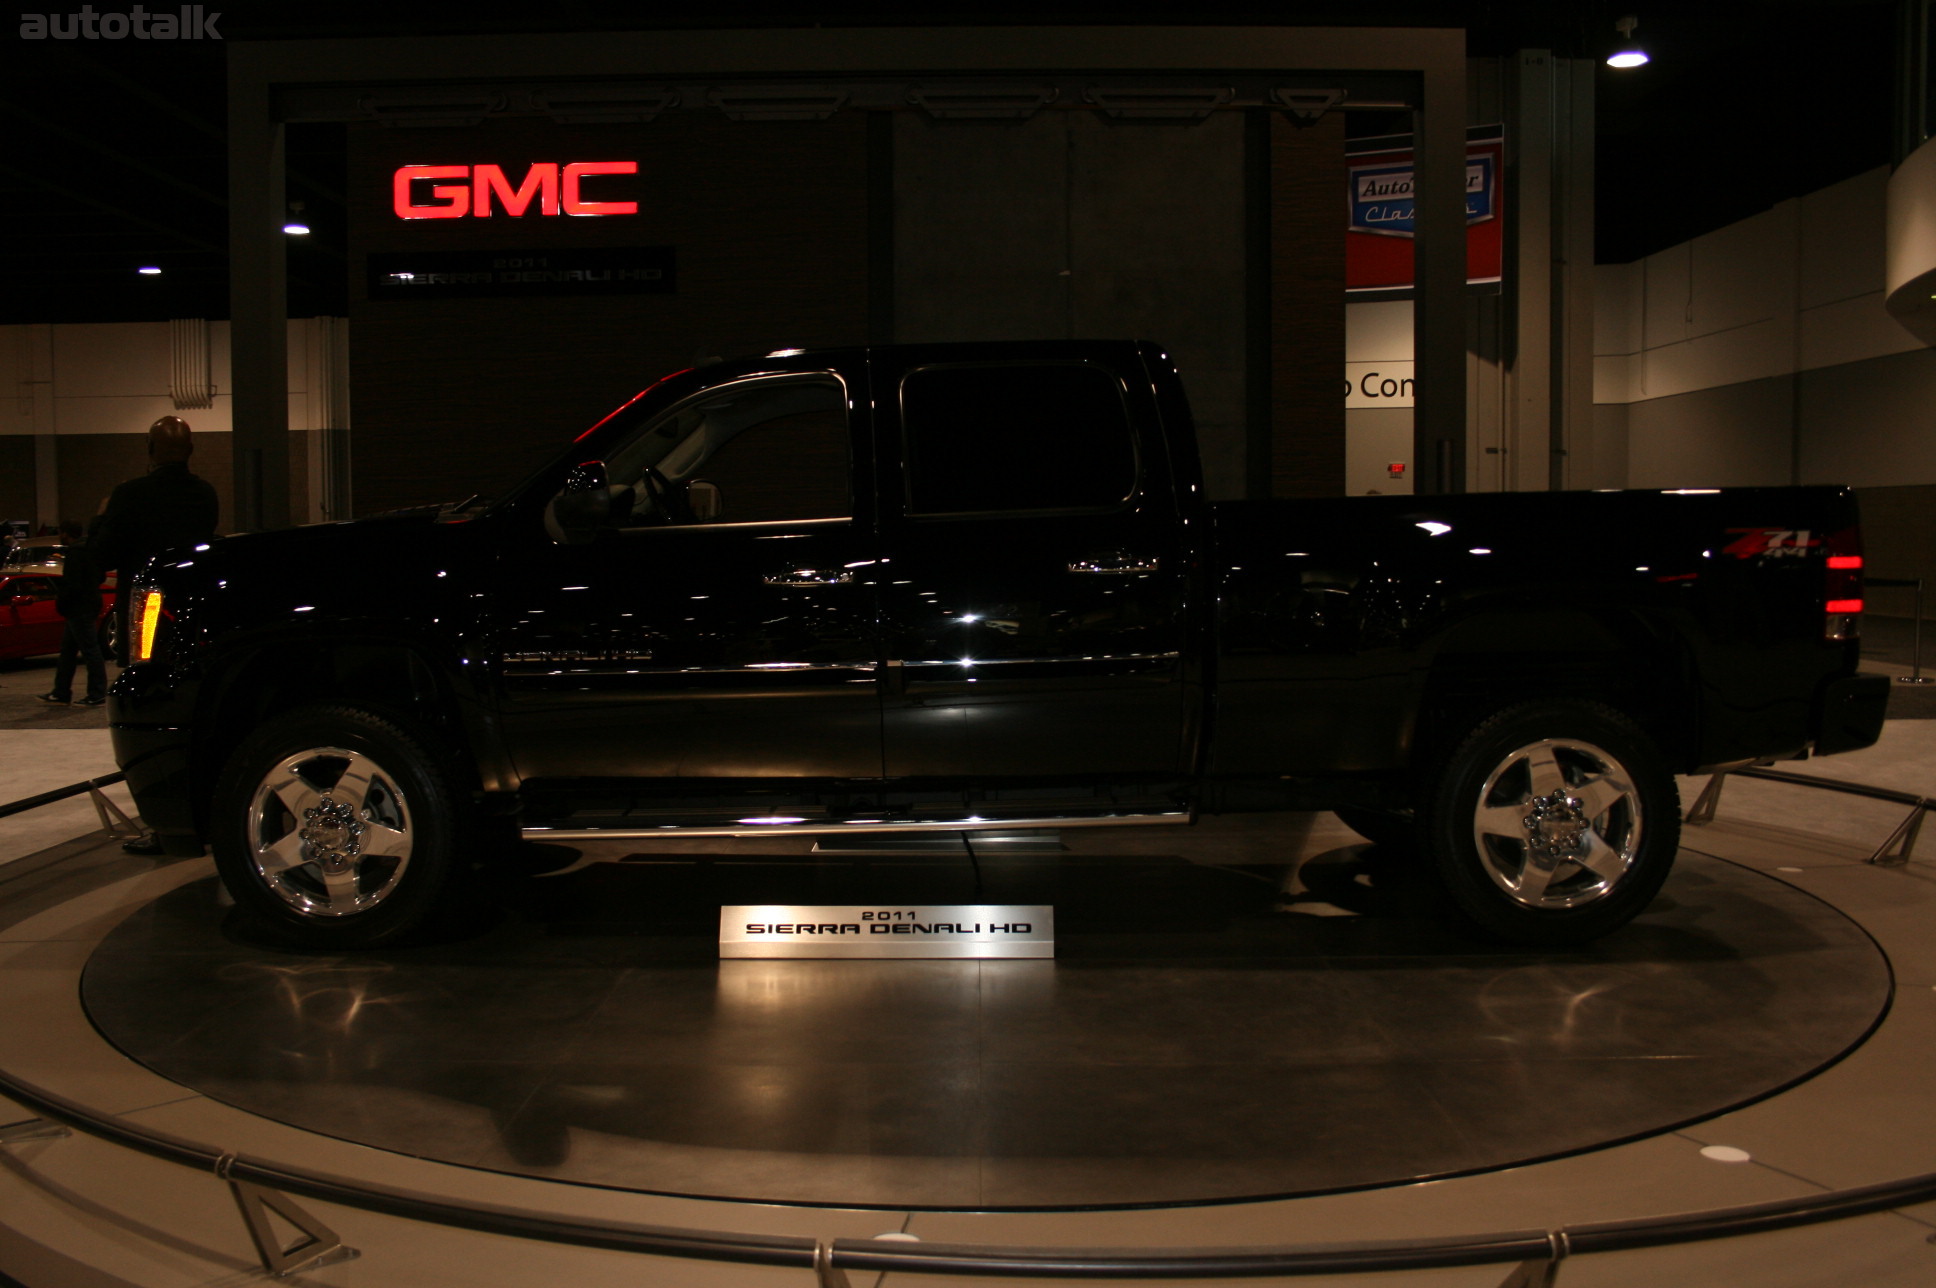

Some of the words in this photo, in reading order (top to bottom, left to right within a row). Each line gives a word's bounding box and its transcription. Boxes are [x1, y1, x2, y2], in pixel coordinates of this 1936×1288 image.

[392, 161, 639, 219] GMC
[493, 257, 548, 269] 2011
[379, 271, 493, 286] SIERRA
[500, 269, 612, 284] DENALI
[618, 269, 662, 282] HD
[862, 911, 917, 921] 2011
[746, 923, 860, 935] SIERRA
[870, 923, 981, 934] DENALI
[989, 923, 1032, 934] HD
